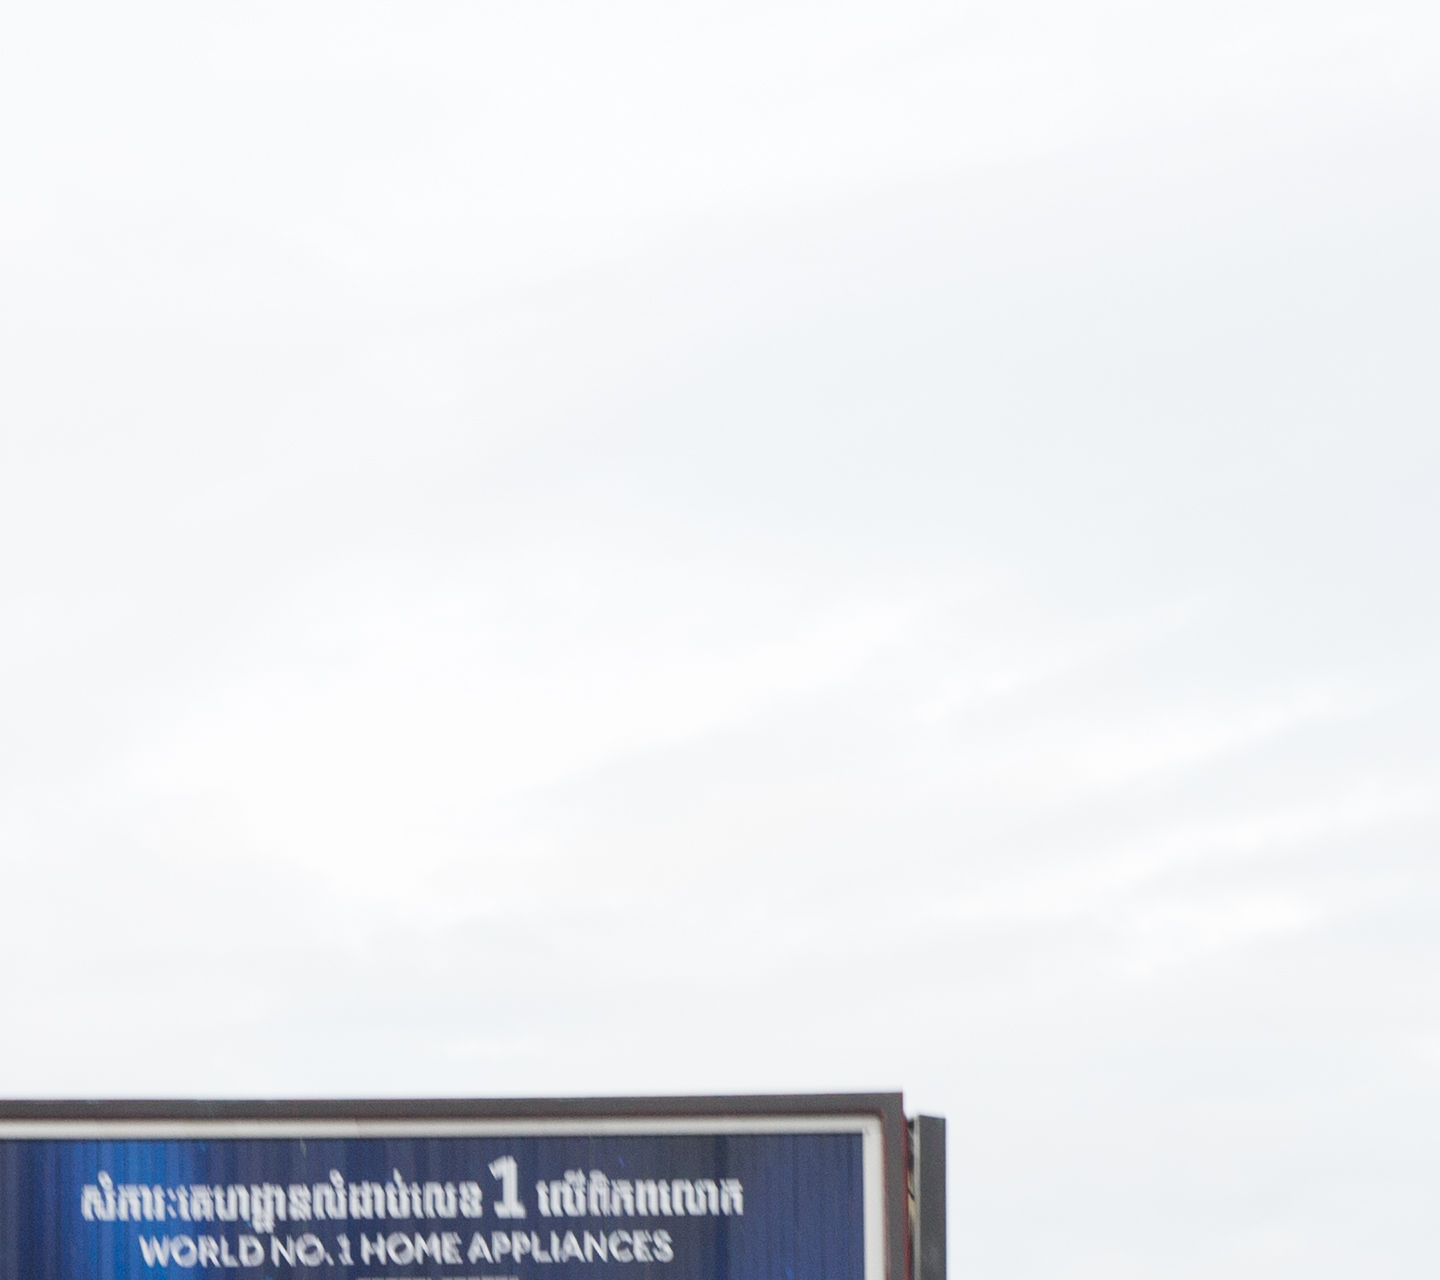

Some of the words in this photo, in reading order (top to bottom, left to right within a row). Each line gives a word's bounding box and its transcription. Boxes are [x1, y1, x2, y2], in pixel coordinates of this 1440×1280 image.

[488, 1156, 527, 1218] 1
[138, 1234, 266, 1267] WORLD
[360, 1231, 463, 1266] HOME
[469, 1228, 675, 1265] APPLIANCES
